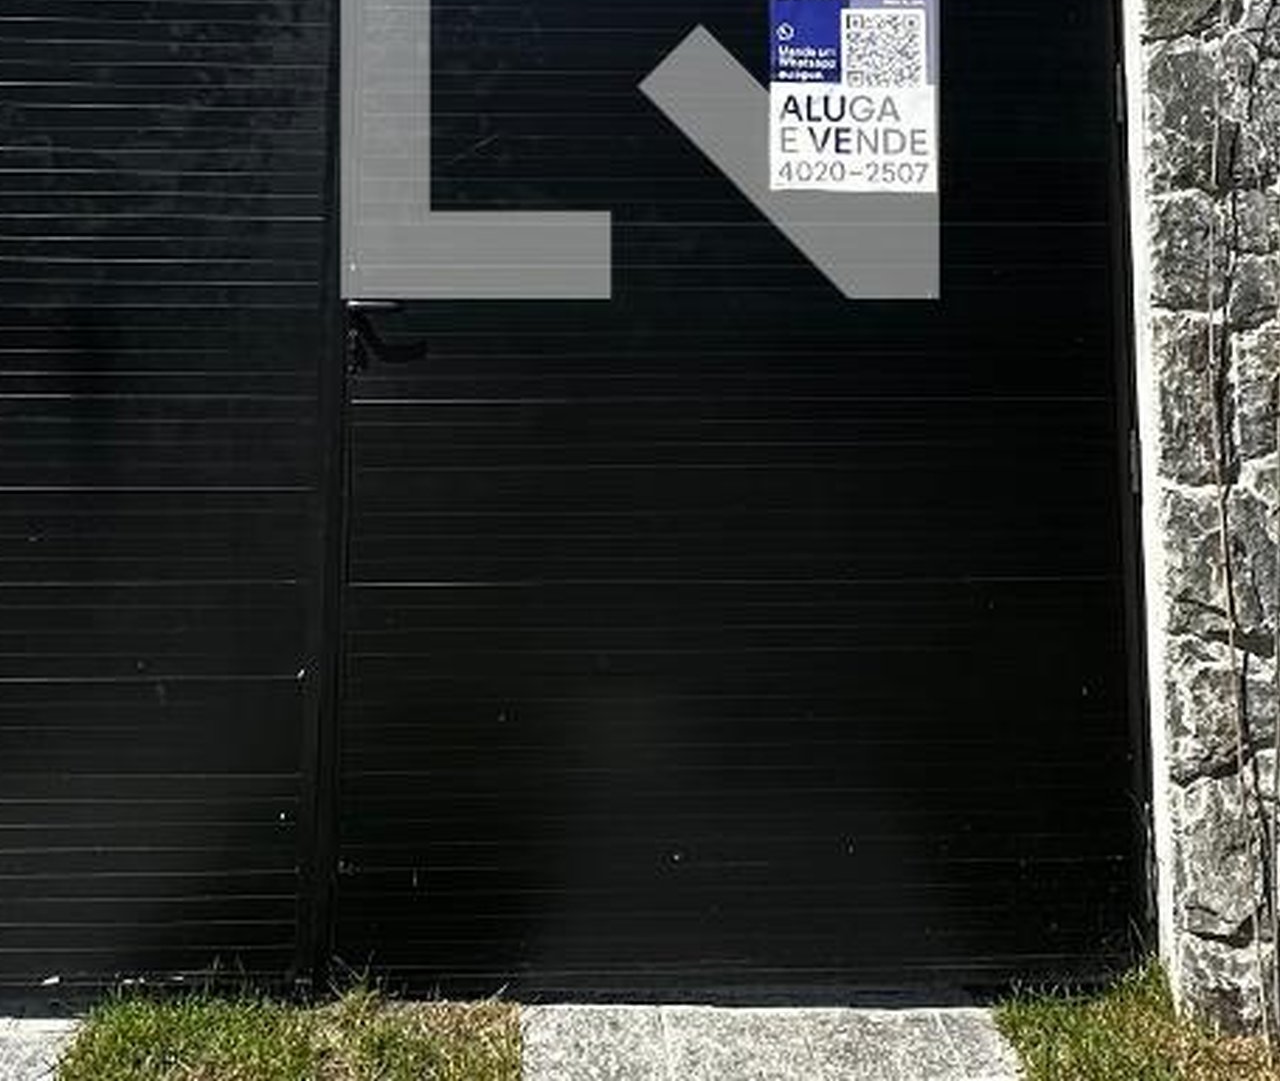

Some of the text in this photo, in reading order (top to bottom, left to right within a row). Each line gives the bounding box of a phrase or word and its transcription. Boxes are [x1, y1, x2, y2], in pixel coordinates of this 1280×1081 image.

[779, 94, 901, 123] ALUGA
[780, 126, 929, 156] E VENDE
[778, 161, 929, 184] 4020-2507
